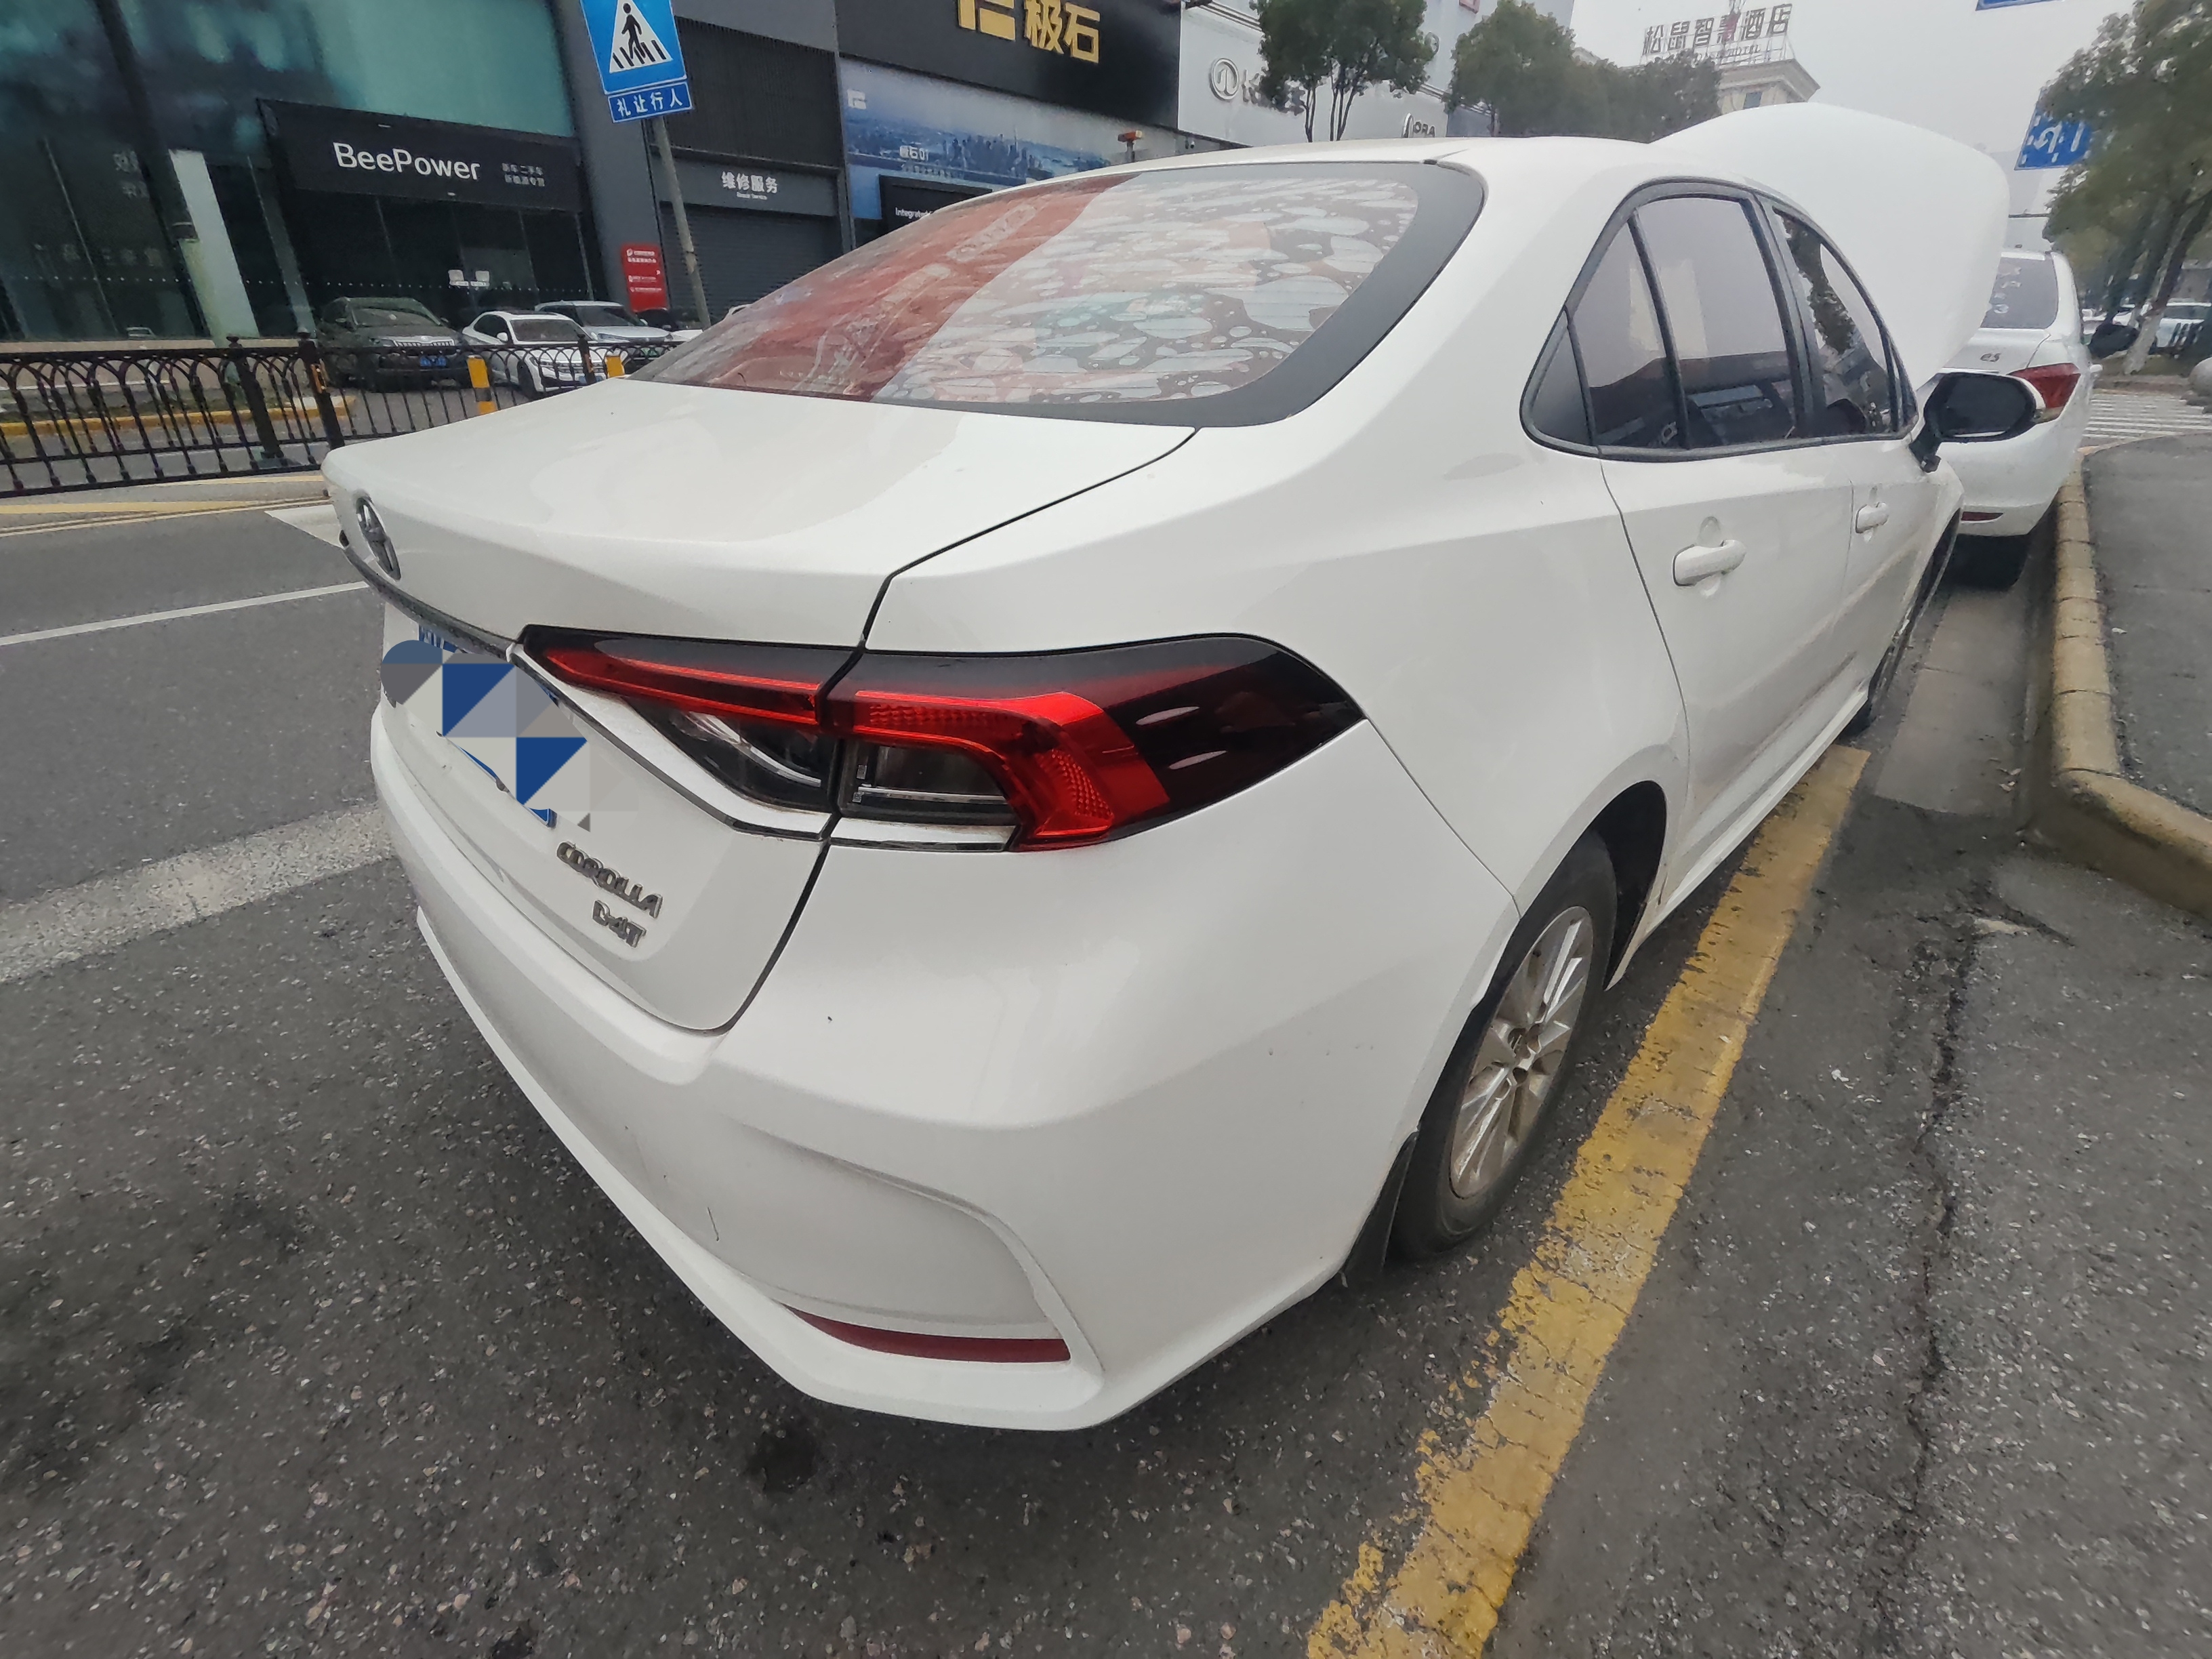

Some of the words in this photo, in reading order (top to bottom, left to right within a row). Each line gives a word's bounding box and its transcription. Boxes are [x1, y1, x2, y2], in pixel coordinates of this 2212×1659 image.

[1024, 0, 1101, 63] 极石
[617, 87, 683, 117] 礼让行人
[1413, 121, 1435, 138] ORA
[333, 142, 480, 180] BeePower
[721, 171, 778, 194] 维修服务
[556, 840, 663, 919] COROLLA
